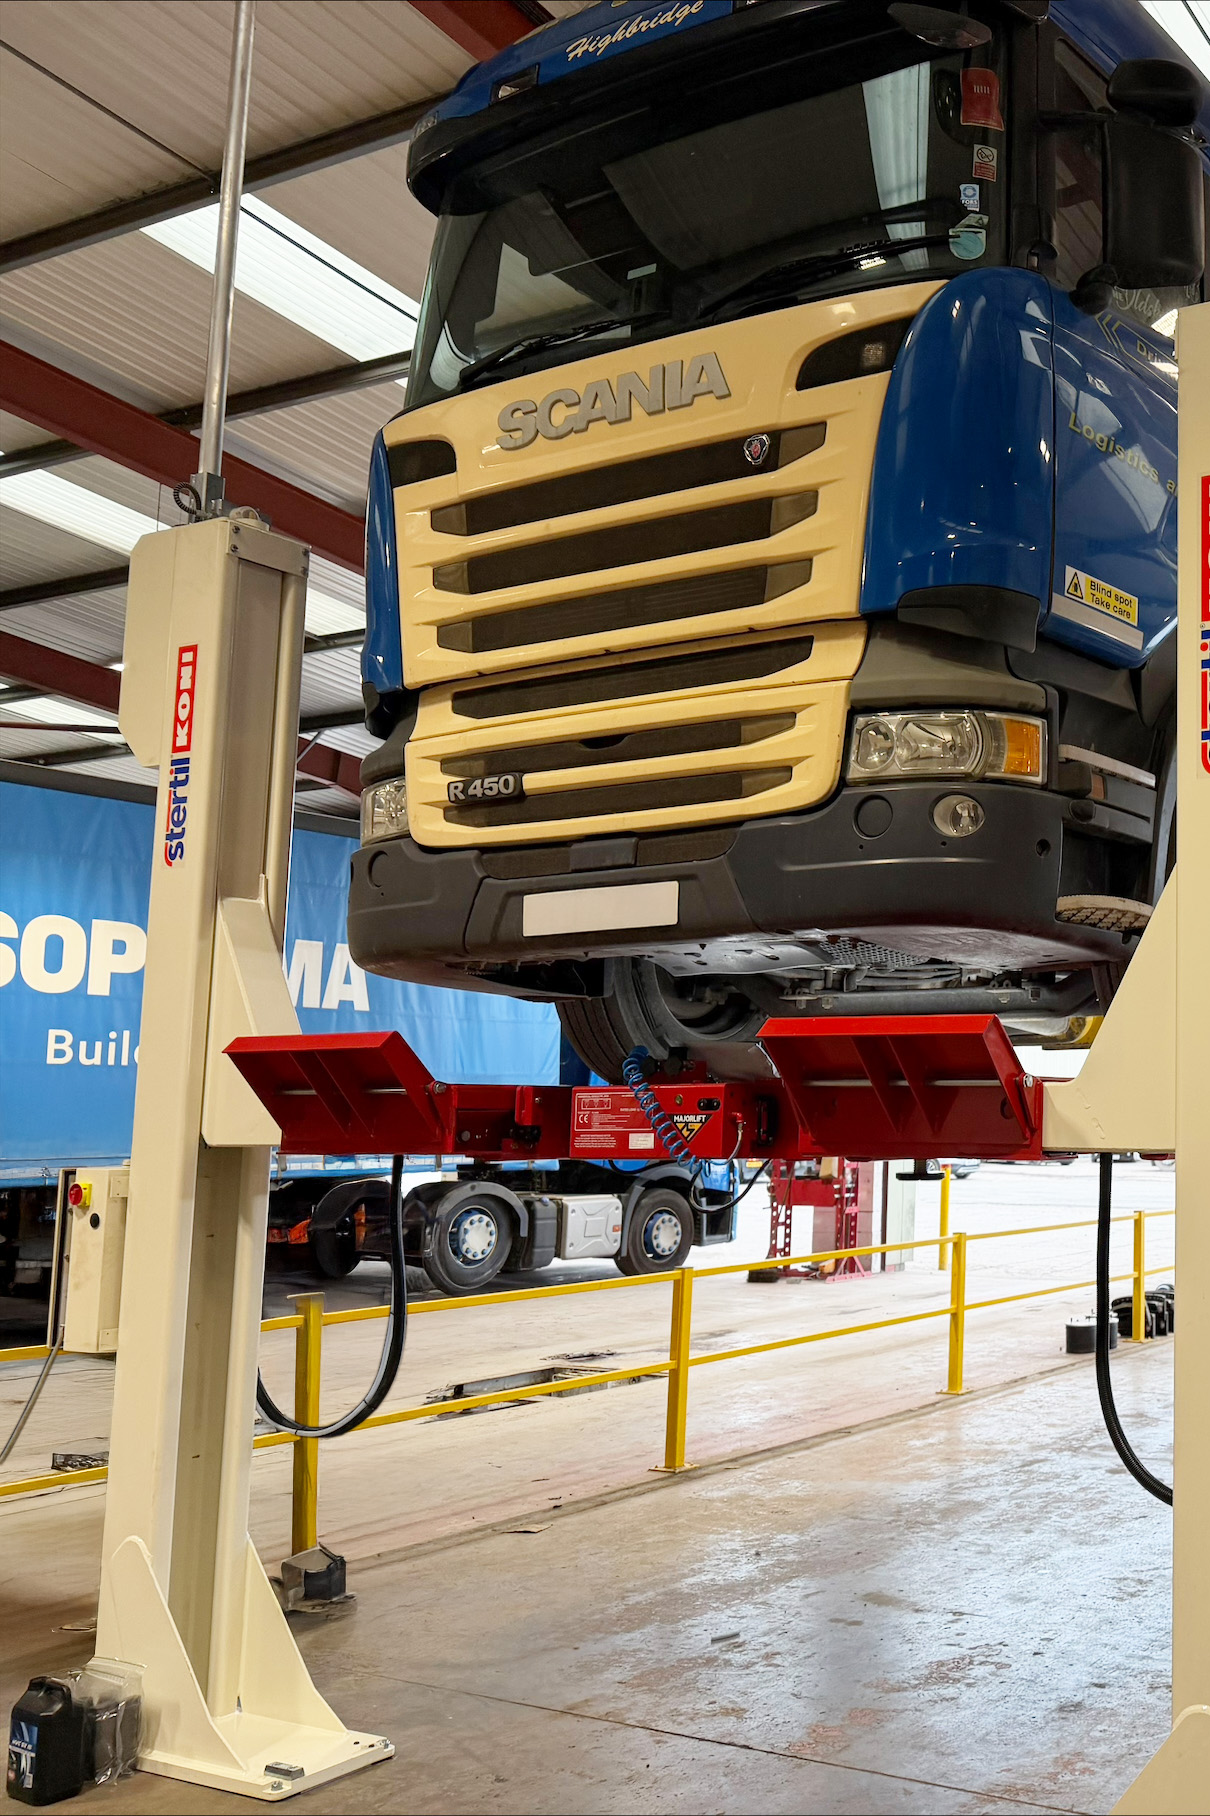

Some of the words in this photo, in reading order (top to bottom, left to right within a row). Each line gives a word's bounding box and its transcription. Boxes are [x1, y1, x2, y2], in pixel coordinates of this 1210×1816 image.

[566, 1, 704, 61] Highbridge
[496, 351, 732, 450] SCANIA
[1069, 412, 1159, 484] Logistics
[1090, 580, 1112, 599] Blind
[1114, 592, 1133, 608] spot
[1090, 593, 1111, 610] Take
[1112, 604, 1131, 619] care
[175, 650, 195, 748] KONI
[165, 757, 190, 864] stertil
[448, 782, 465, 801] R
[467, 774, 515, 797] 450
[46, 1029, 140, 1066] Buil
[673, 1114, 707, 1123] MAJORLIFT
